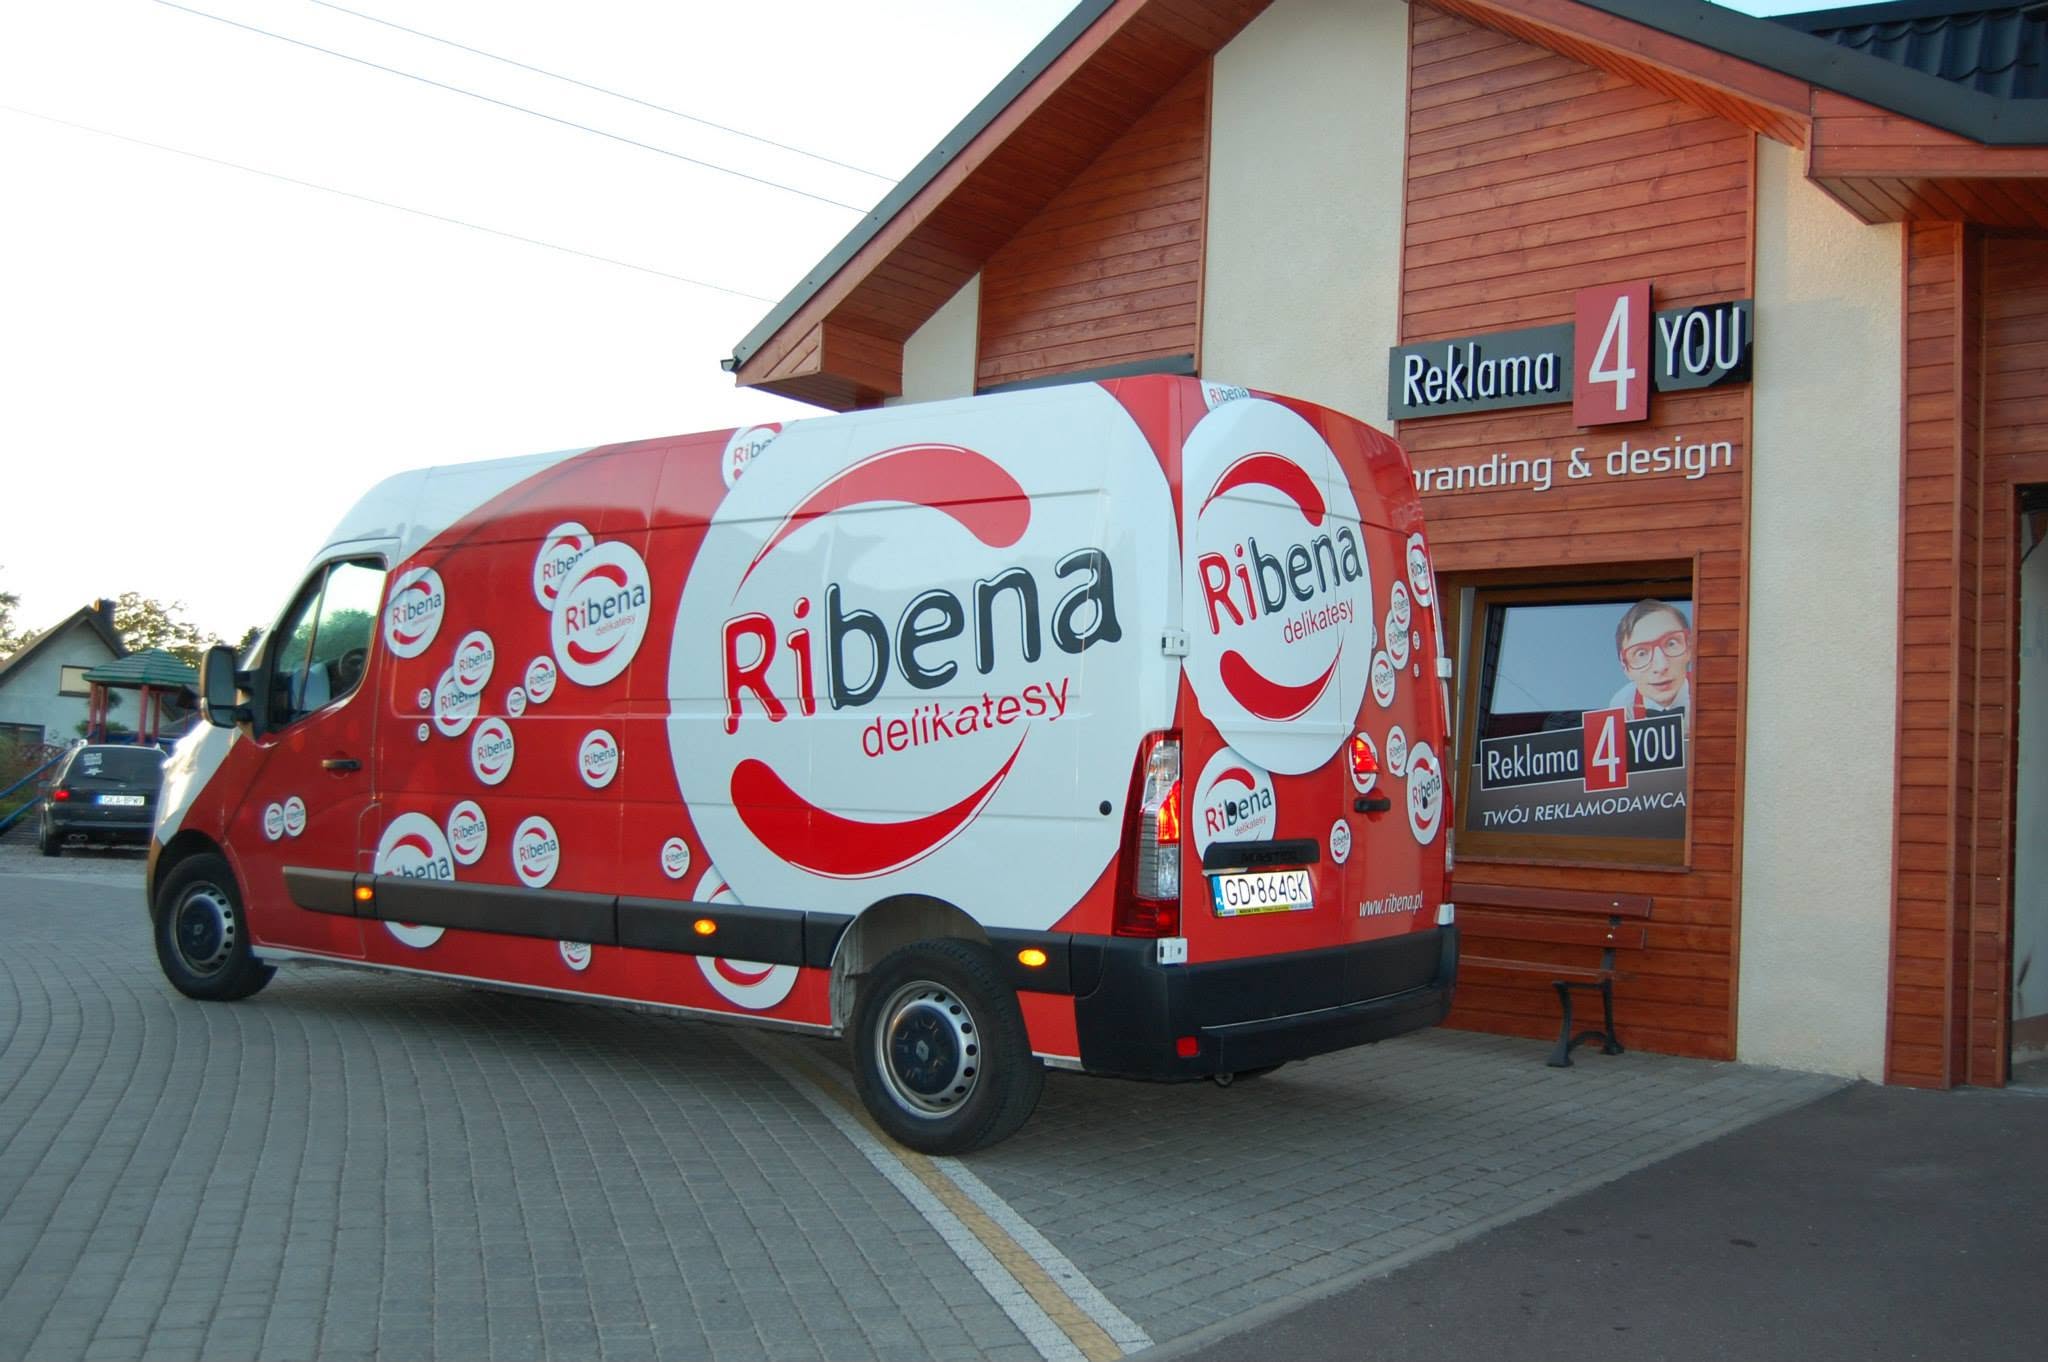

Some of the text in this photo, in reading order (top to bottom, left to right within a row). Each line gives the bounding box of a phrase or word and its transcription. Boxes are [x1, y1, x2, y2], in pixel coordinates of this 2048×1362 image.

[1403, 296, 1743, 411] Reklama 4 YOU
[1567, 447, 1592, 480] &
[1606, 435, 1732, 480] design
[1197, 526, 1363, 635] Ribena
[391, 593, 442, 626] Ribena
[565, 584, 646, 636] Ribena
[1283, 598, 1354, 644] delikatesy
[458, 649, 493, 674] Ribena
[721, 547, 1122, 735] Ribena
[862, 676, 1070, 759] delikatesy
[477, 737, 513, 761] Ribena
[584, 747, 616, 767] Ribena
[1487, 716, 1677, 783] Reklama 4 YOU
[1205, 788, 1272, 837] Ribena
[1482, 790, 1687, 827] TWÓJ REKLAMODAWCA
[452, 820, 486, 842] Ribena
[519, 838, 558, 862] Ribena
[1225, 873, 1309, 906] GD 864GK
[1359, 889, 1424, 917] www.ribena.pl
